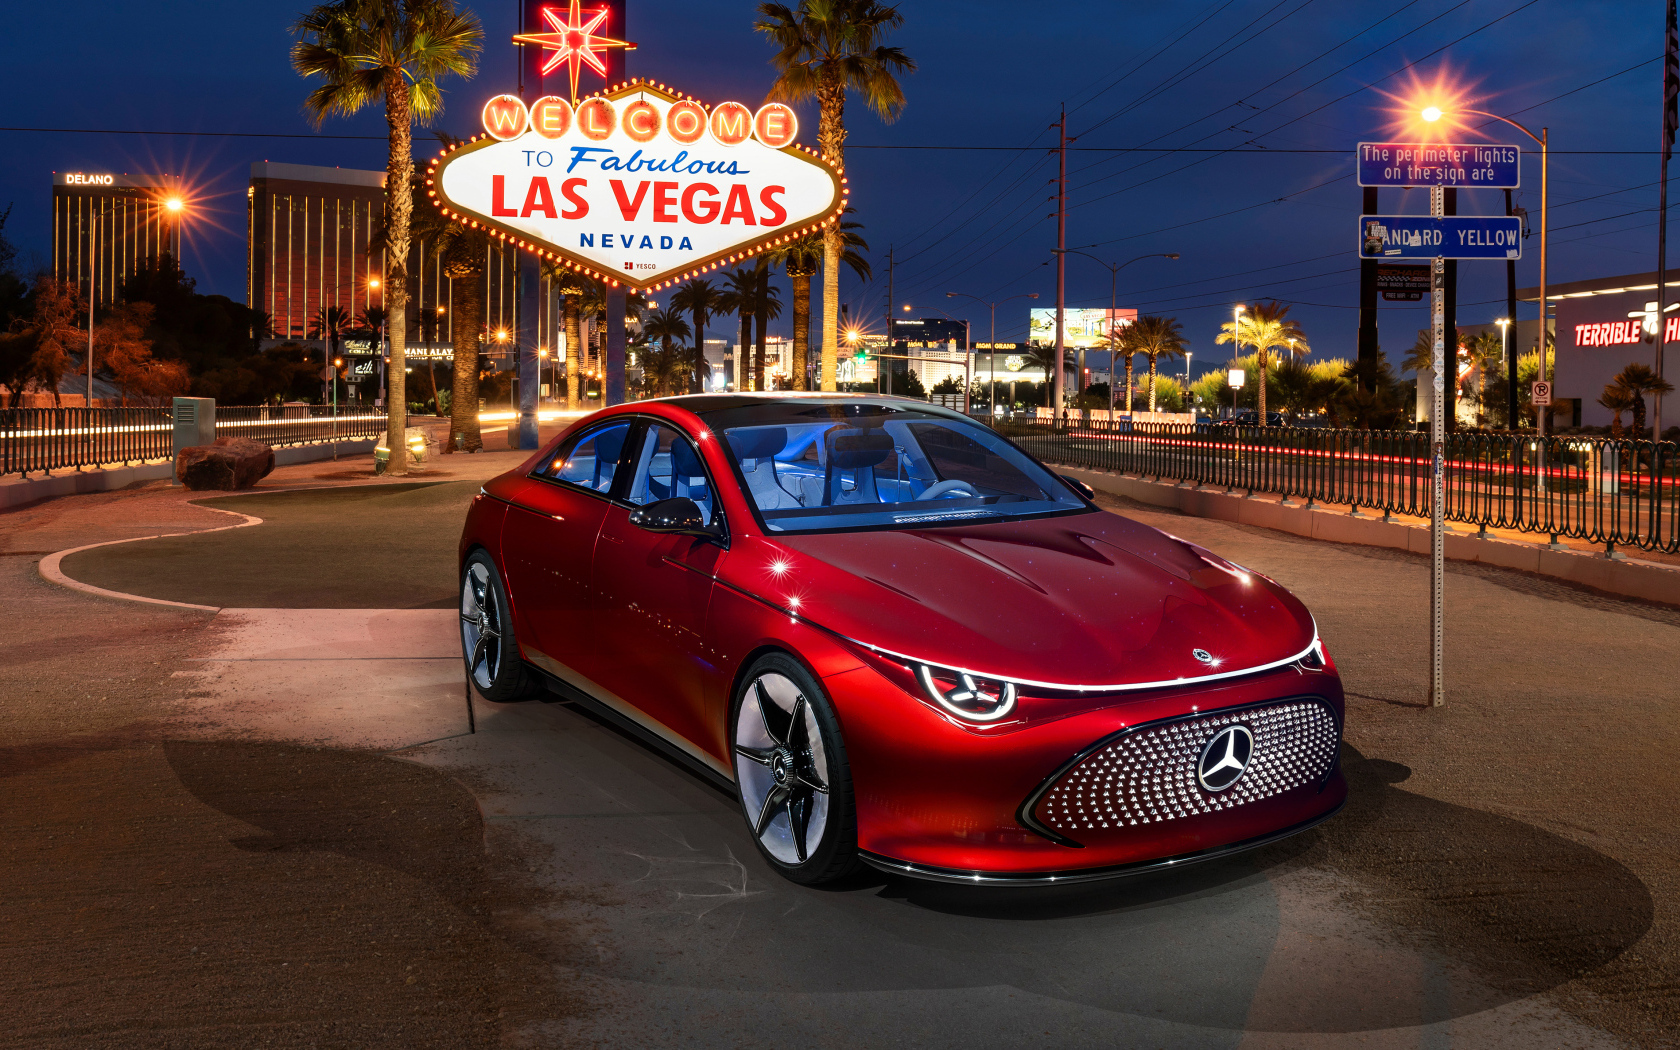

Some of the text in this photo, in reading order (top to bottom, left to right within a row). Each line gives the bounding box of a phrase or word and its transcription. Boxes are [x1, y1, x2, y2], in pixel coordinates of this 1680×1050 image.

[490, 103, 787, 140] WELCOME
[522, 146, 750, 176] TO Fabulous
[1362, 145, 1515, 168] The perimeter lights
[66, 174, 114, 185] DELANO
[1384, 165, 1494, 184] on the sign are
[491, 174, 788, 227] LAS VEGAS
[580, 232, 693, 250] NEVADA
[1457, 230, 1517, 246] YELLOW
[1575, 317, 1680, 348] TERRIBLE H
